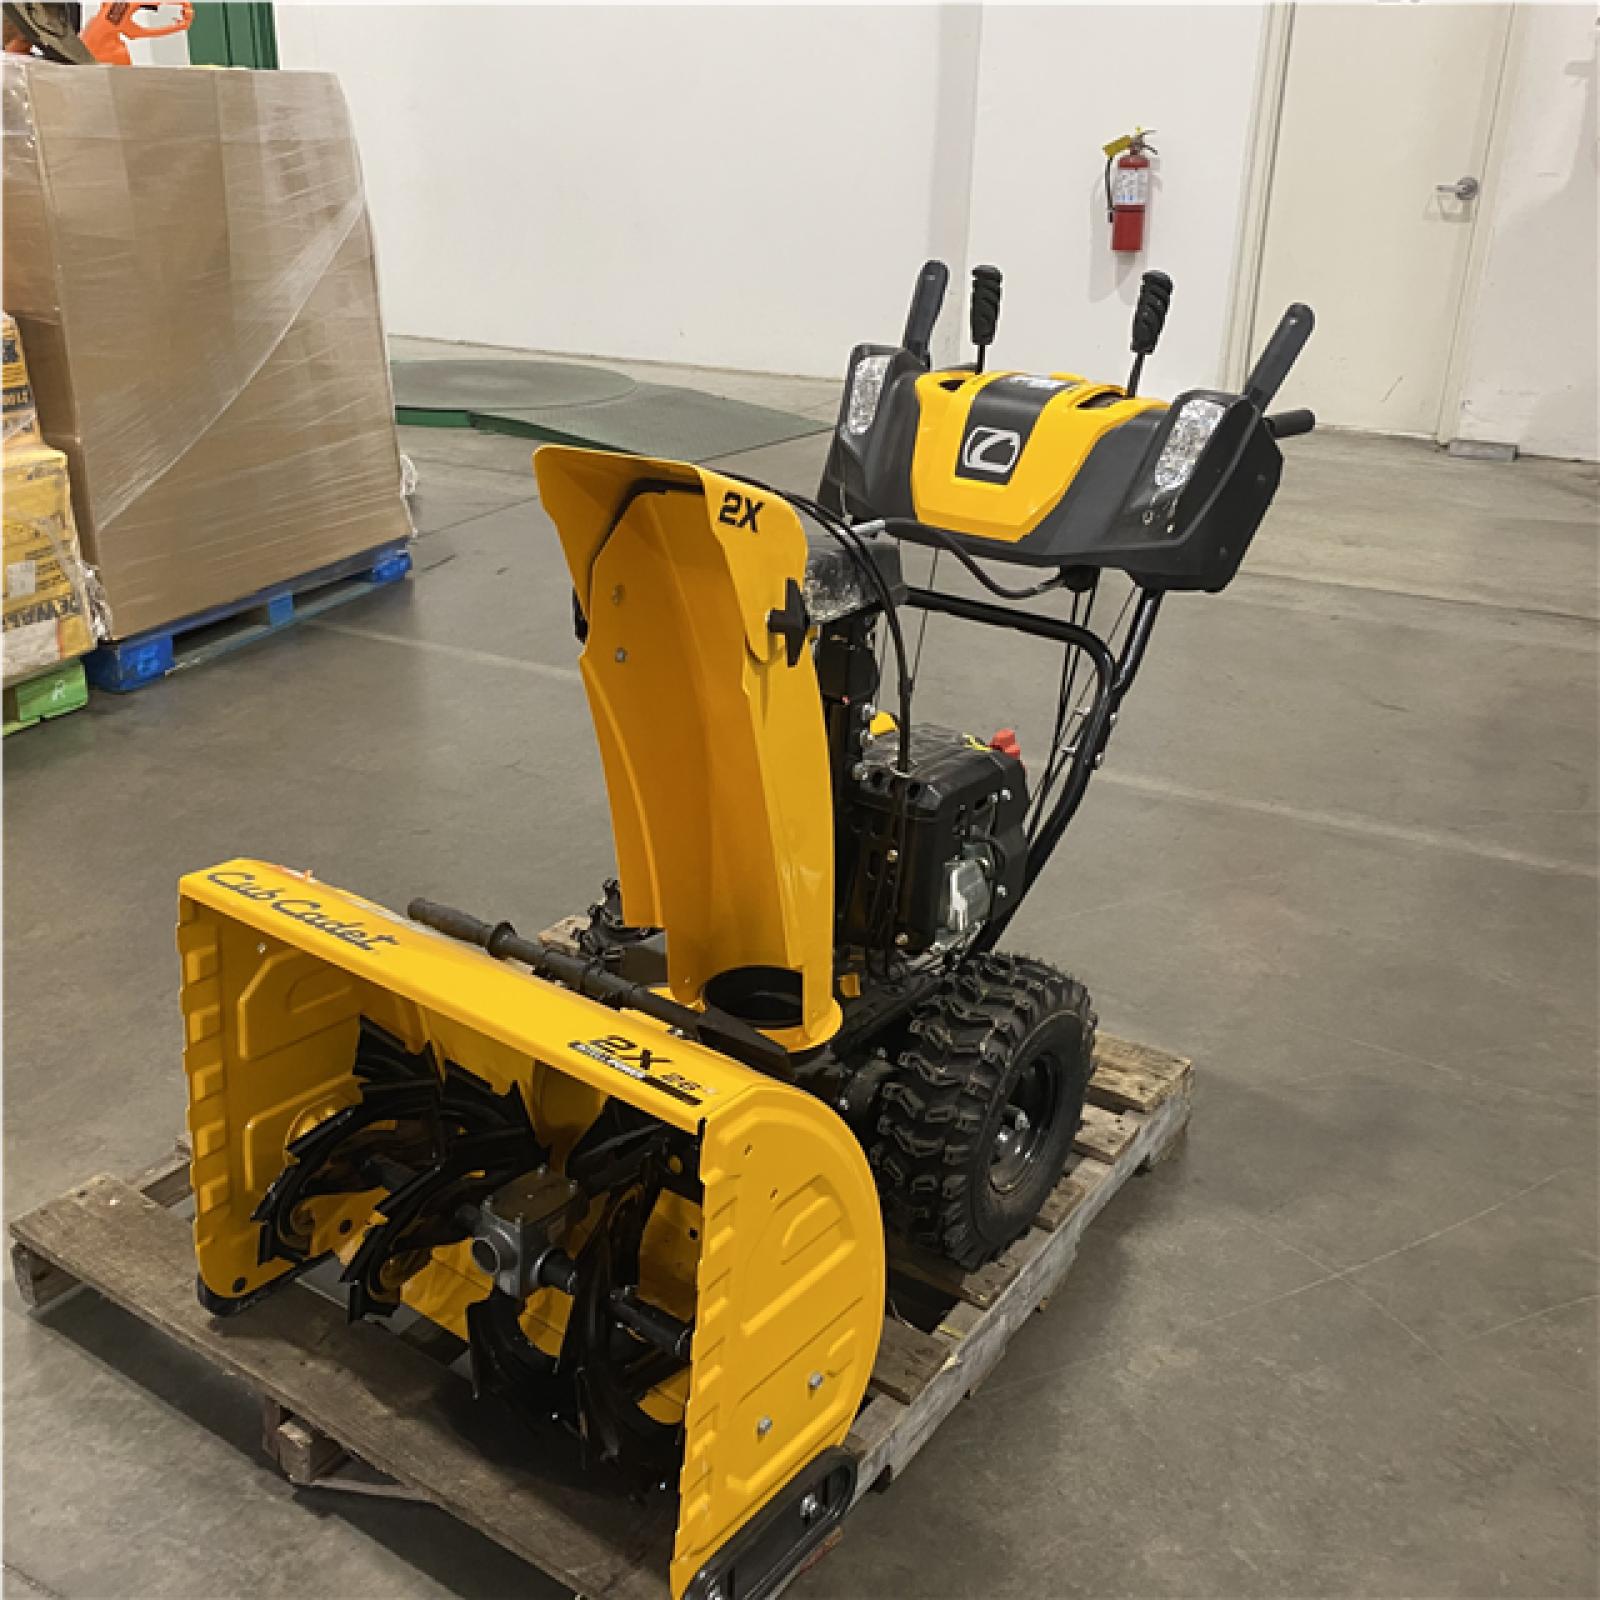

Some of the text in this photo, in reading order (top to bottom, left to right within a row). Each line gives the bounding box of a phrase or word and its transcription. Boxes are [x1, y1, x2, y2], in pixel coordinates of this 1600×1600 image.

[719, 490, 763, 533] 2X
[207, 871, 399, 951] Cub Cadet
[589, 1035, 672, 1070] 2X
